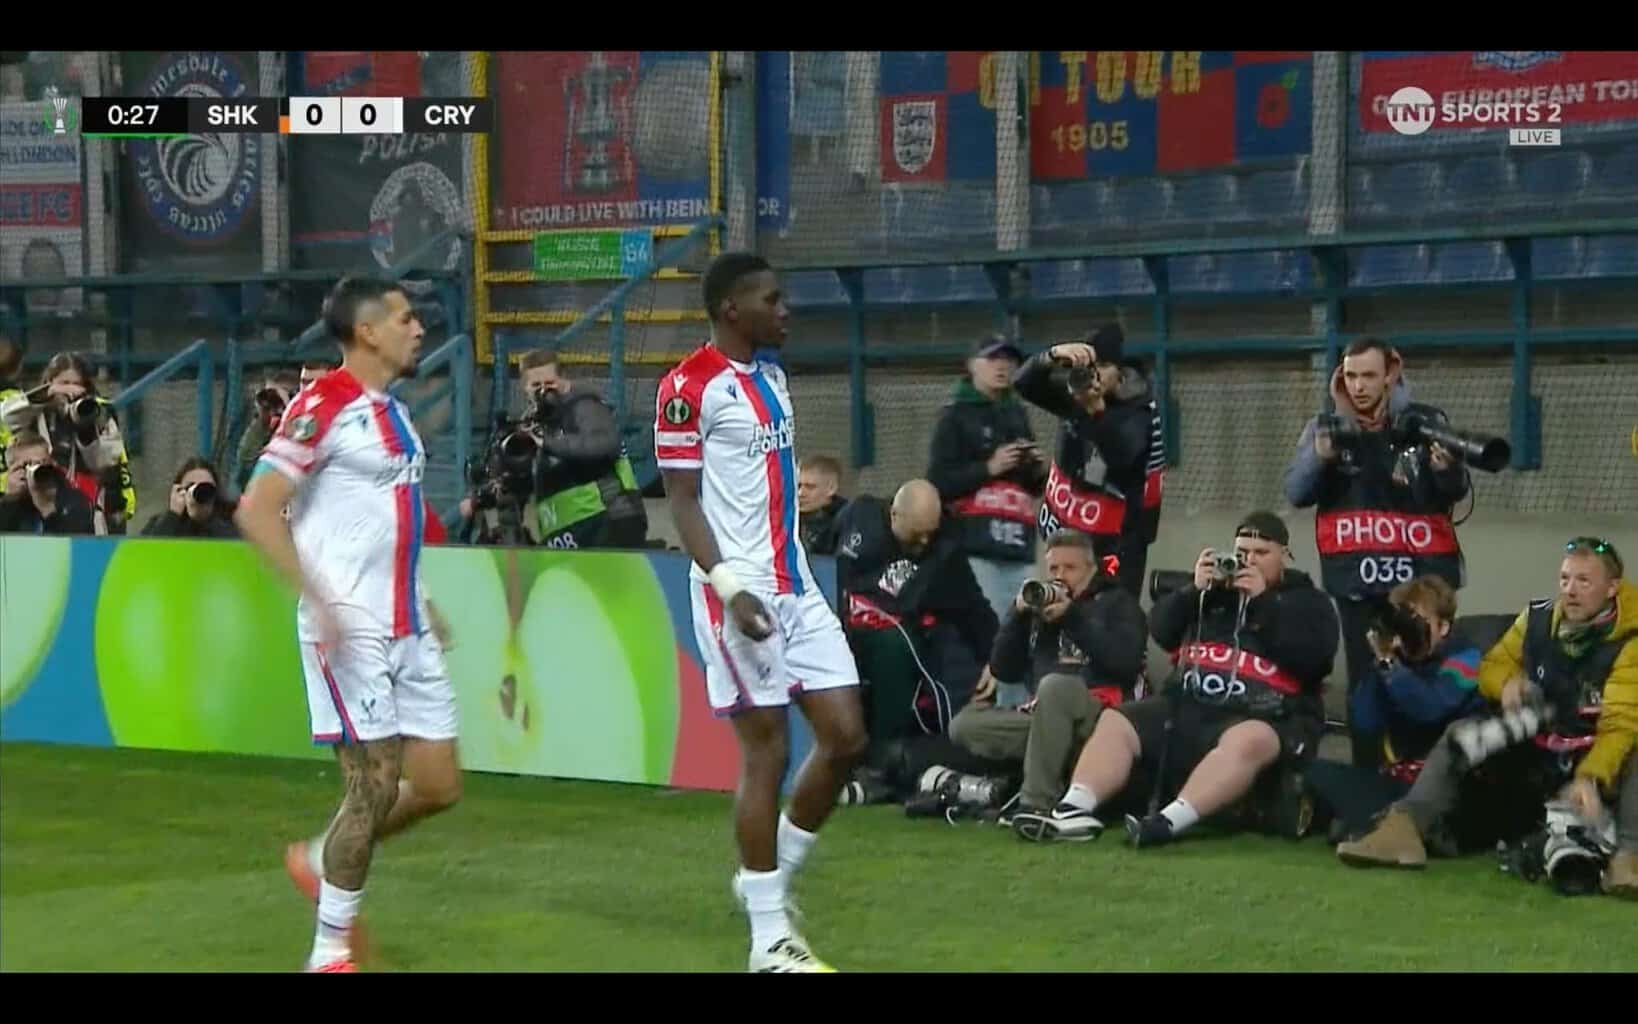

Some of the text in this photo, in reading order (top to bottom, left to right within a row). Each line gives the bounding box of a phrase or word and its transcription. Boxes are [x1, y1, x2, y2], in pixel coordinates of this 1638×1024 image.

[1050, 119, 1130, 152] 1905
[520, 206, 578, 225] COULD
[578, 201, 616, 223] LIVE
[618, 200, 663, 220] WITH
[665, 198, 711, 218] BEIN
[1045, 463, 1101, 526] HOTO
[1336, 515, 1432, 548] PHOTO
[1359, 555, 1414, 584] 035
